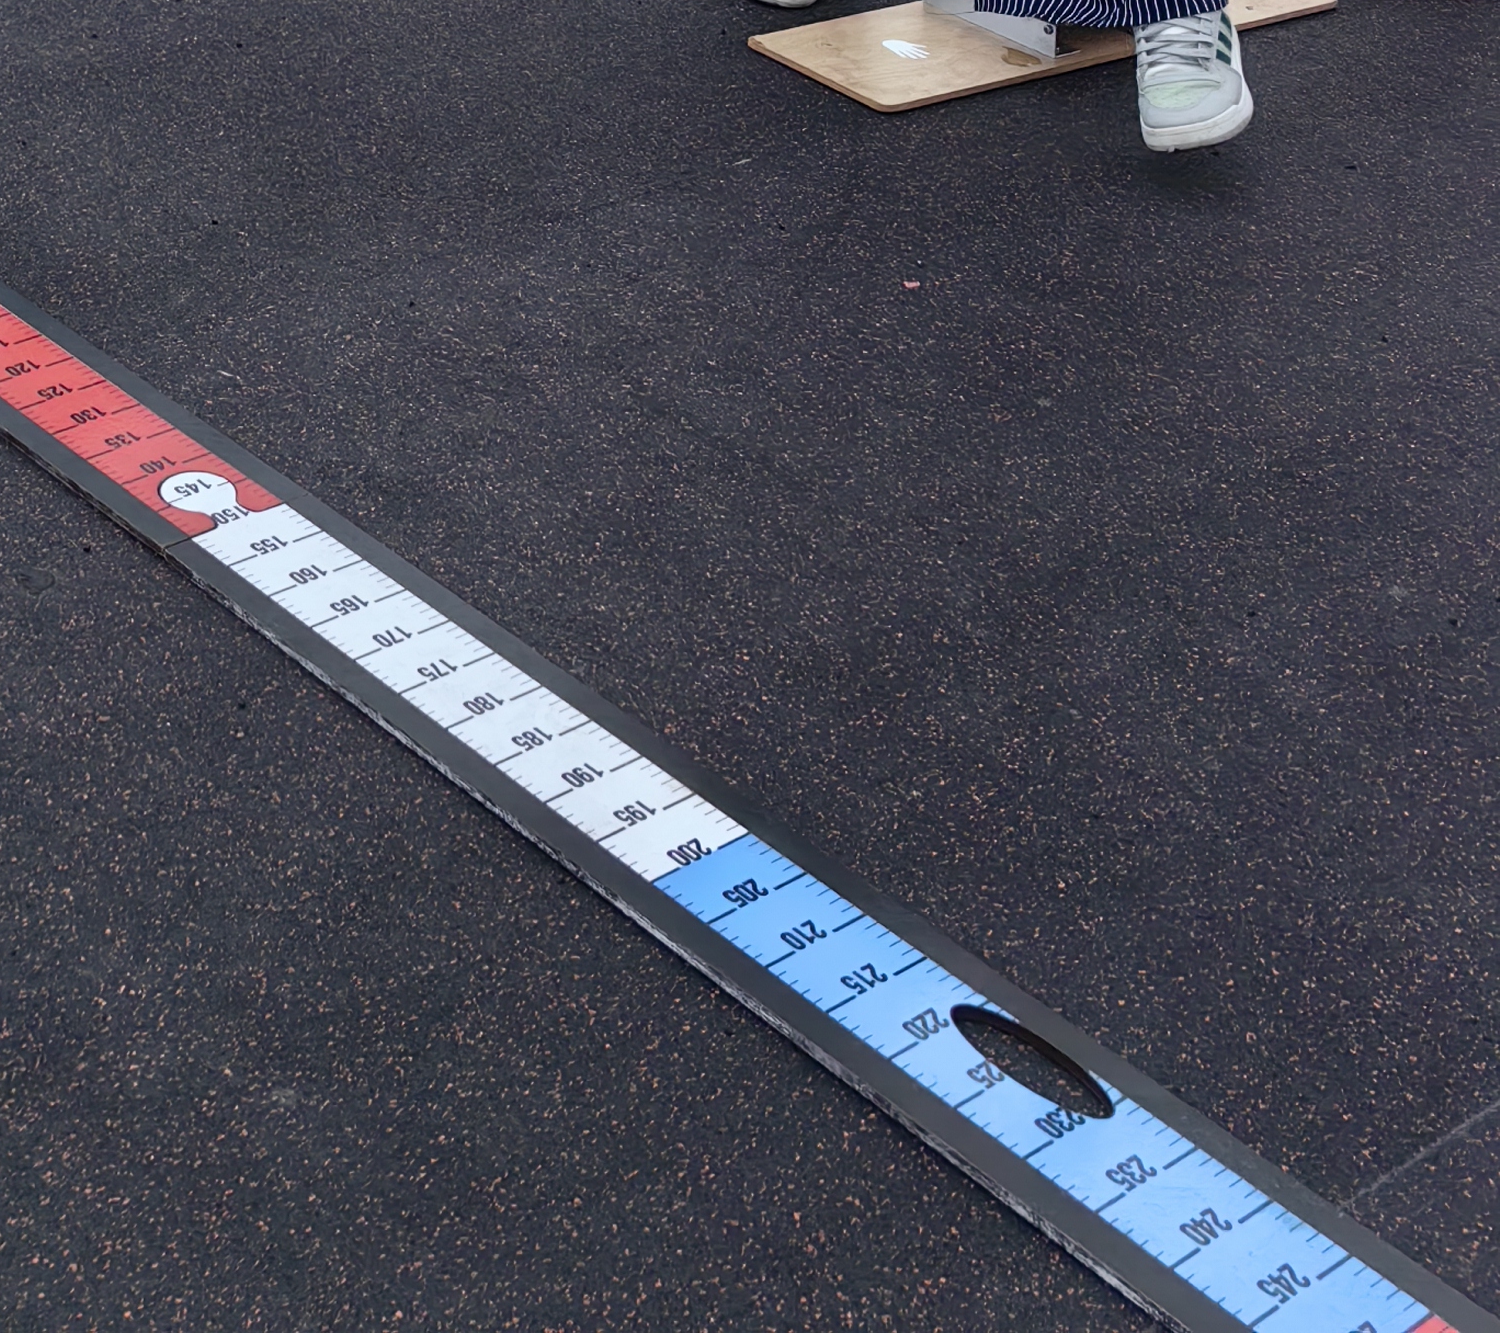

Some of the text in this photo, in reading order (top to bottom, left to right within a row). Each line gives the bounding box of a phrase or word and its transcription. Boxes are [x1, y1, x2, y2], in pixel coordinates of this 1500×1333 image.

[4, 359, 41, 377] 120
[37, 383, 73, 401] 125
[69, 406, 107, 424] 130
[104, 431, 141, 449] 135
[139, 456, 177, 475] 140
[173, 479, 212, 499] 145
[211, 505, 249, 526] 150
[250, 535, 289, 556] 155
[288, 564, 329, 584] 160
[329, 594, 370, 617] 165
[372, 626, 413, 648] 170
[417, 659, 459, 682] 175
[462, 692, 506, 716] 180
[511, 726, 553, 751] 185
[561, 762, 605, 788] 190
[612, 800, 657, 827] 195
[666, 837, 712, 866] 200
[722, 878, 769, 908] 205
[780, 919, 828, 950] 210
[840, 962, 888, 995] 215
[902, 1007, 950, 1040] 220
[966, 1060, 1005, 1089] 25
[1034, 1106, 1086, 1139] 230
[1105, 1154, 1158, 1192] 235
[1178, 1208, 1233, 1246] 240
[1256, 1263, 1311, 1304] 245
